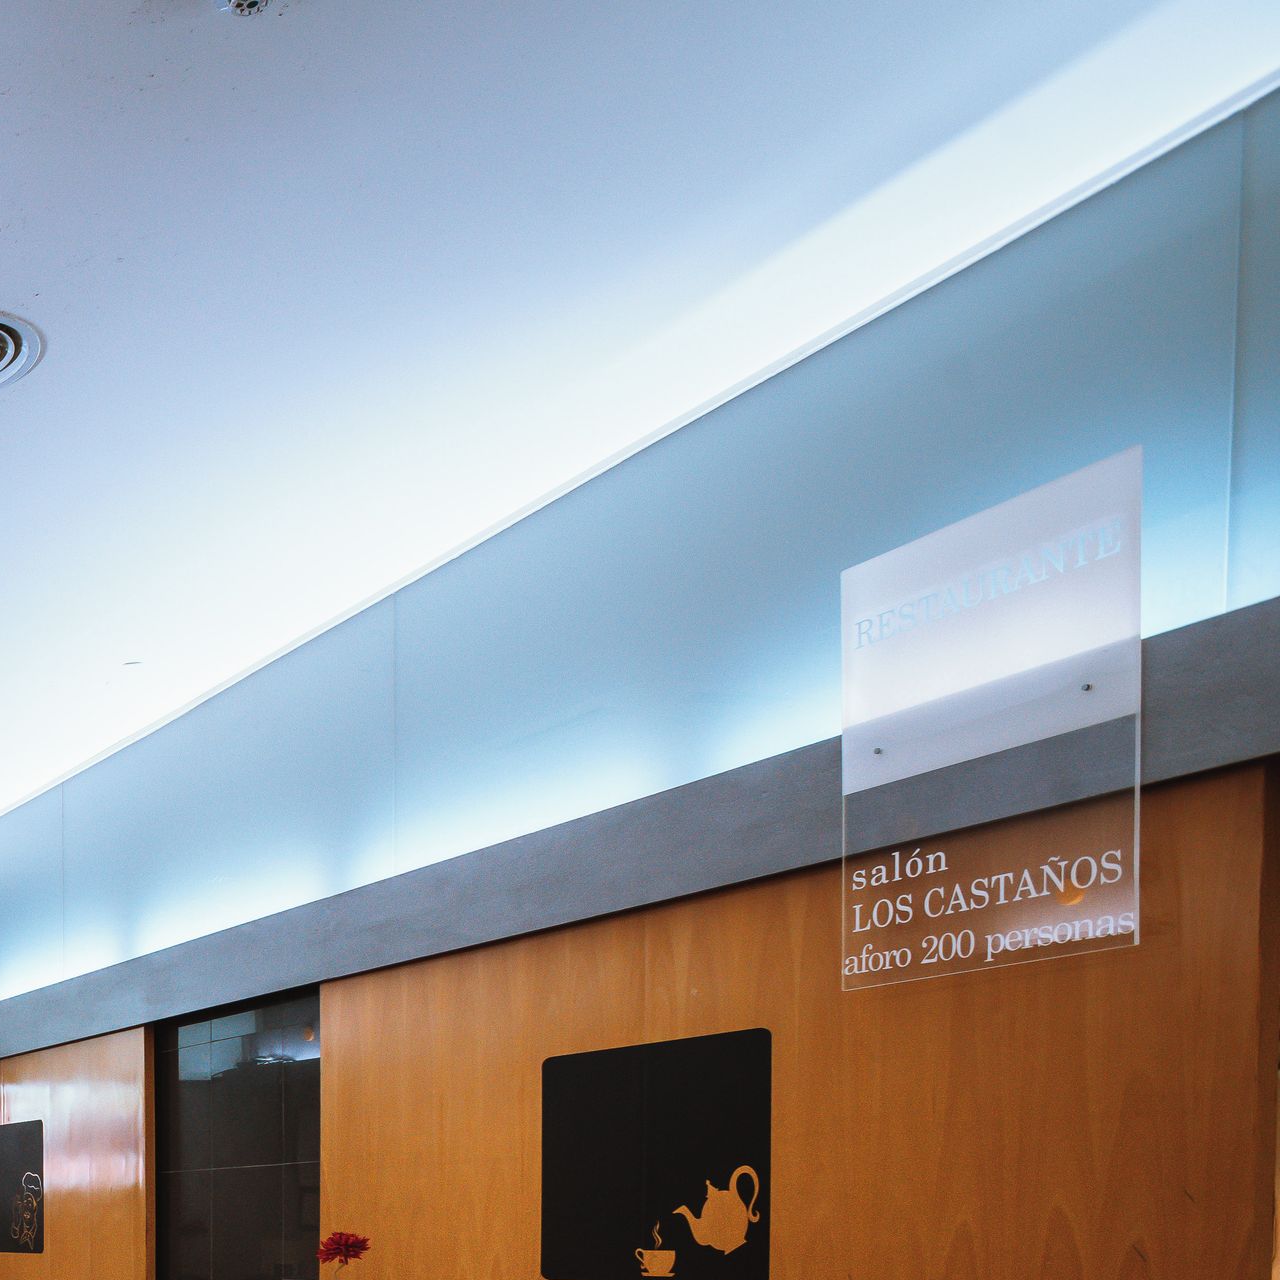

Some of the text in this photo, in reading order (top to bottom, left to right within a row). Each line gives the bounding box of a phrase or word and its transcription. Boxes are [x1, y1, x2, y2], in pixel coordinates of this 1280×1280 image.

[855, 517, 1122, 649] RESTAURANTE
[851, 848, 949, 891] salón
[852, 849, 1124, 933] LOS CASTAÑOS
[843, 911, 1136, 976] aforo 200 personas
